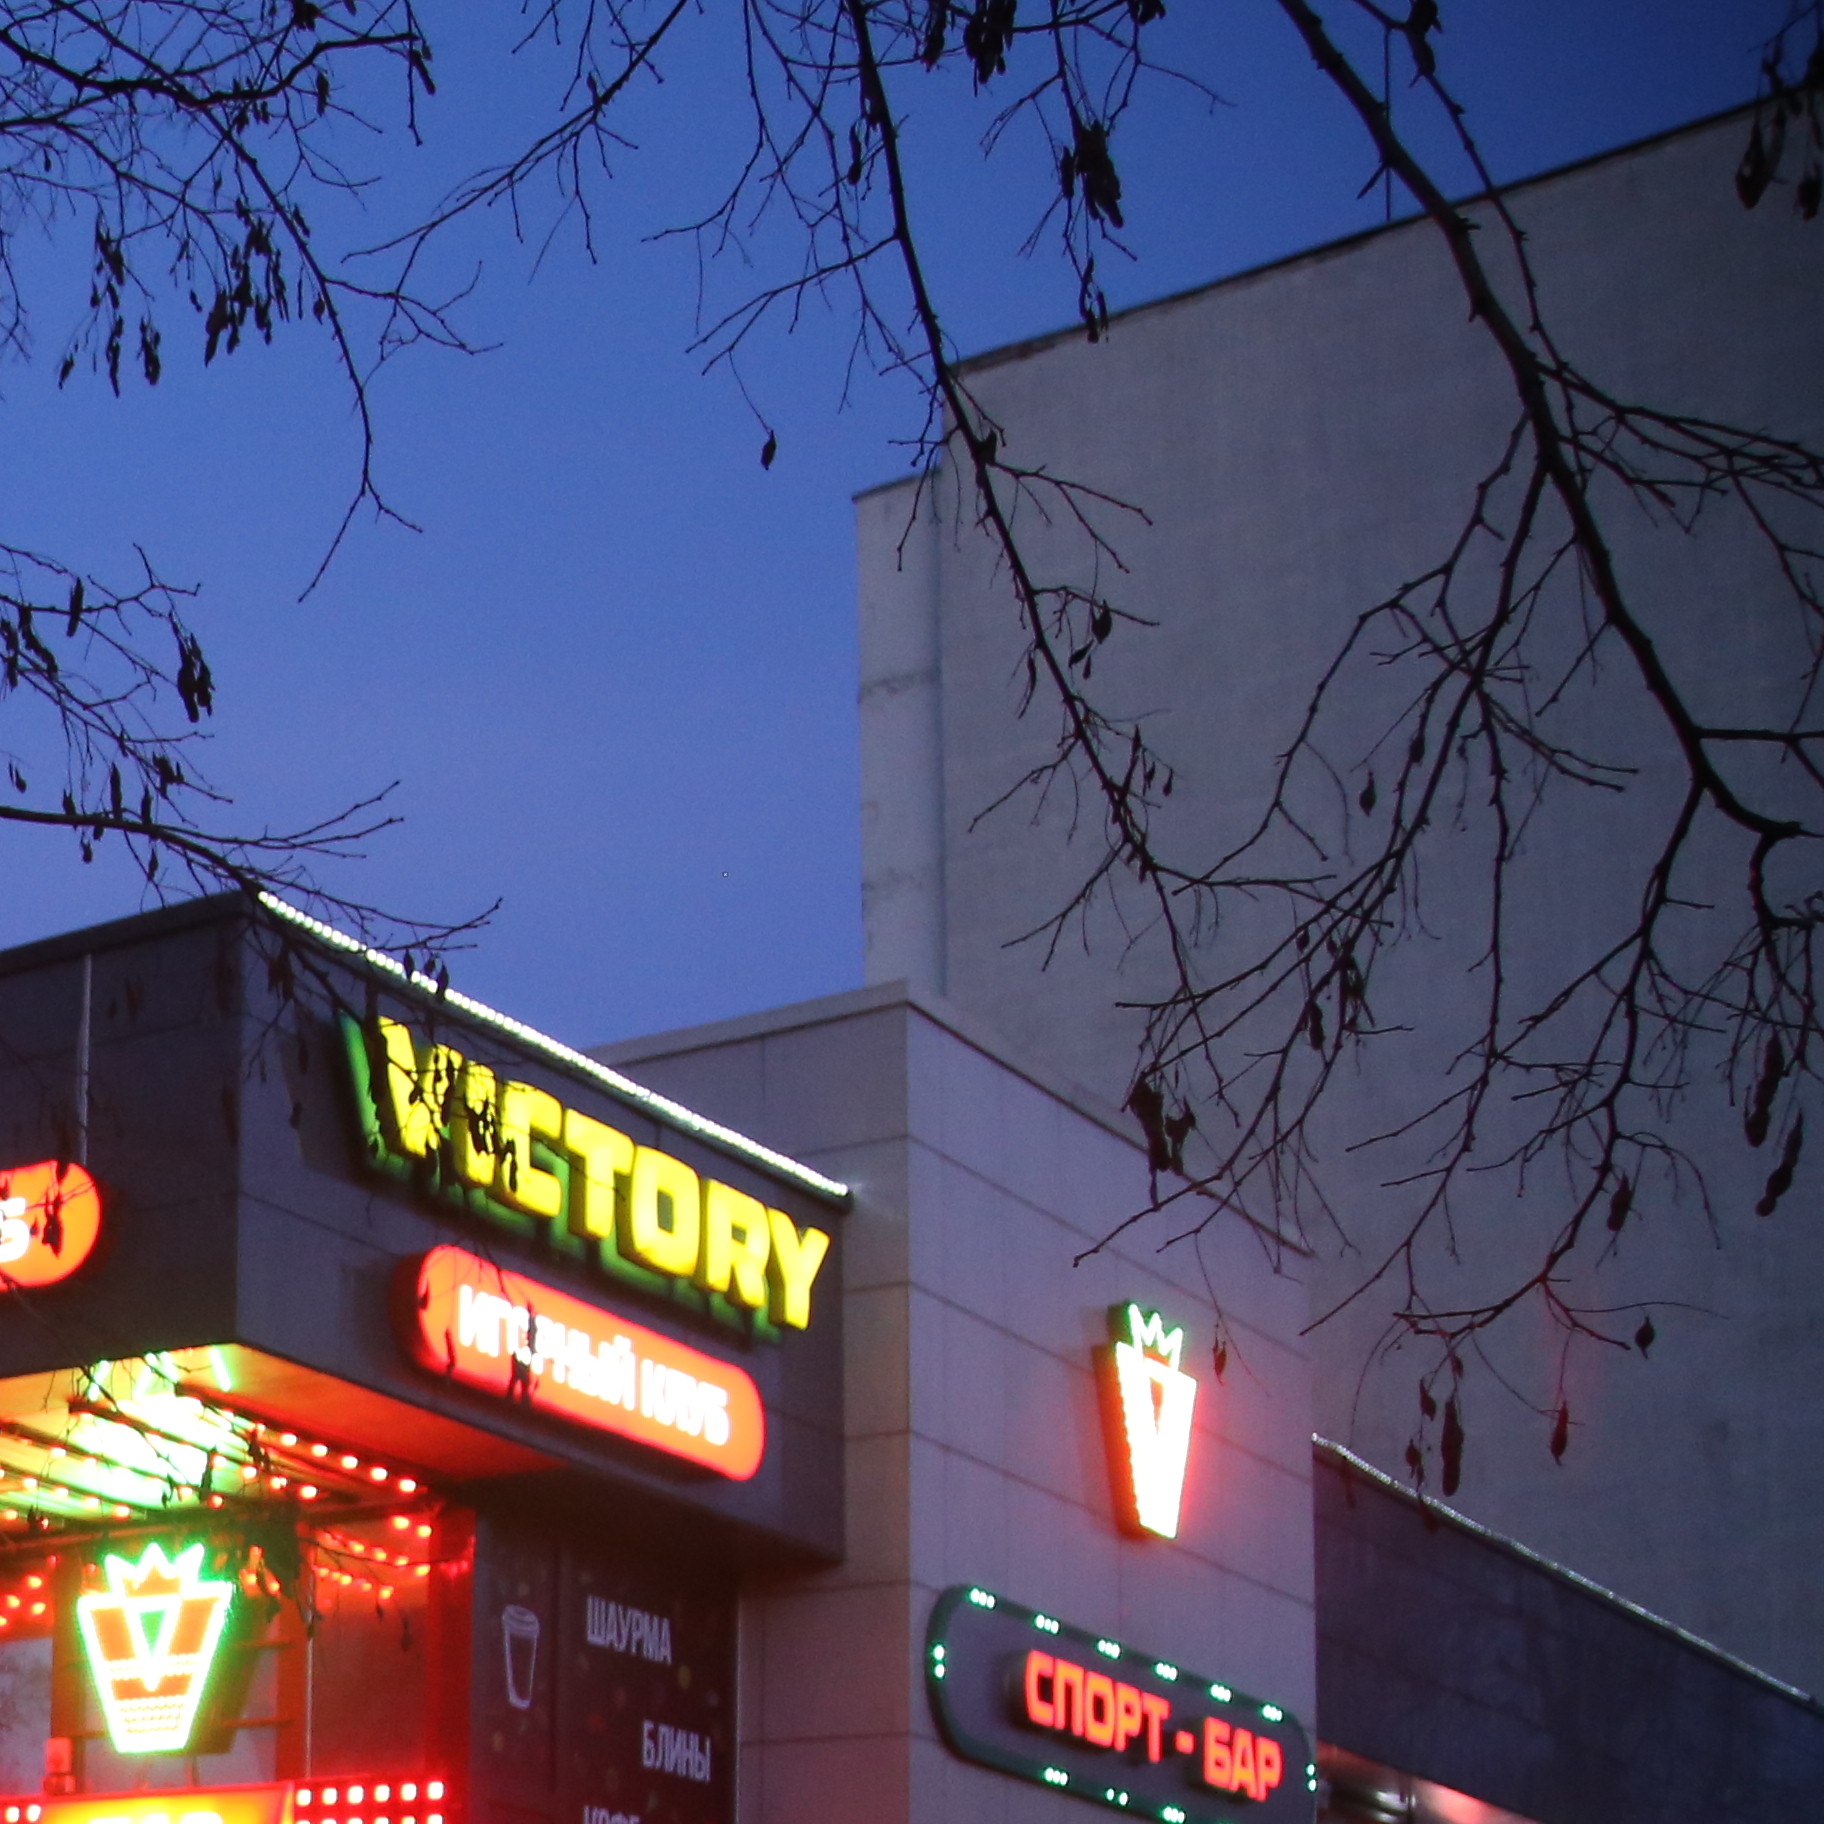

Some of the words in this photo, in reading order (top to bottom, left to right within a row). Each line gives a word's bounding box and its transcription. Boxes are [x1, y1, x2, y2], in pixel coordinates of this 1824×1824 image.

[372, 1014, 832, 1333] VICTORY
[585, 1594, 673, 1667] ШАУРМА
[641, 1719, 712, 1784] БЛИНЫ
